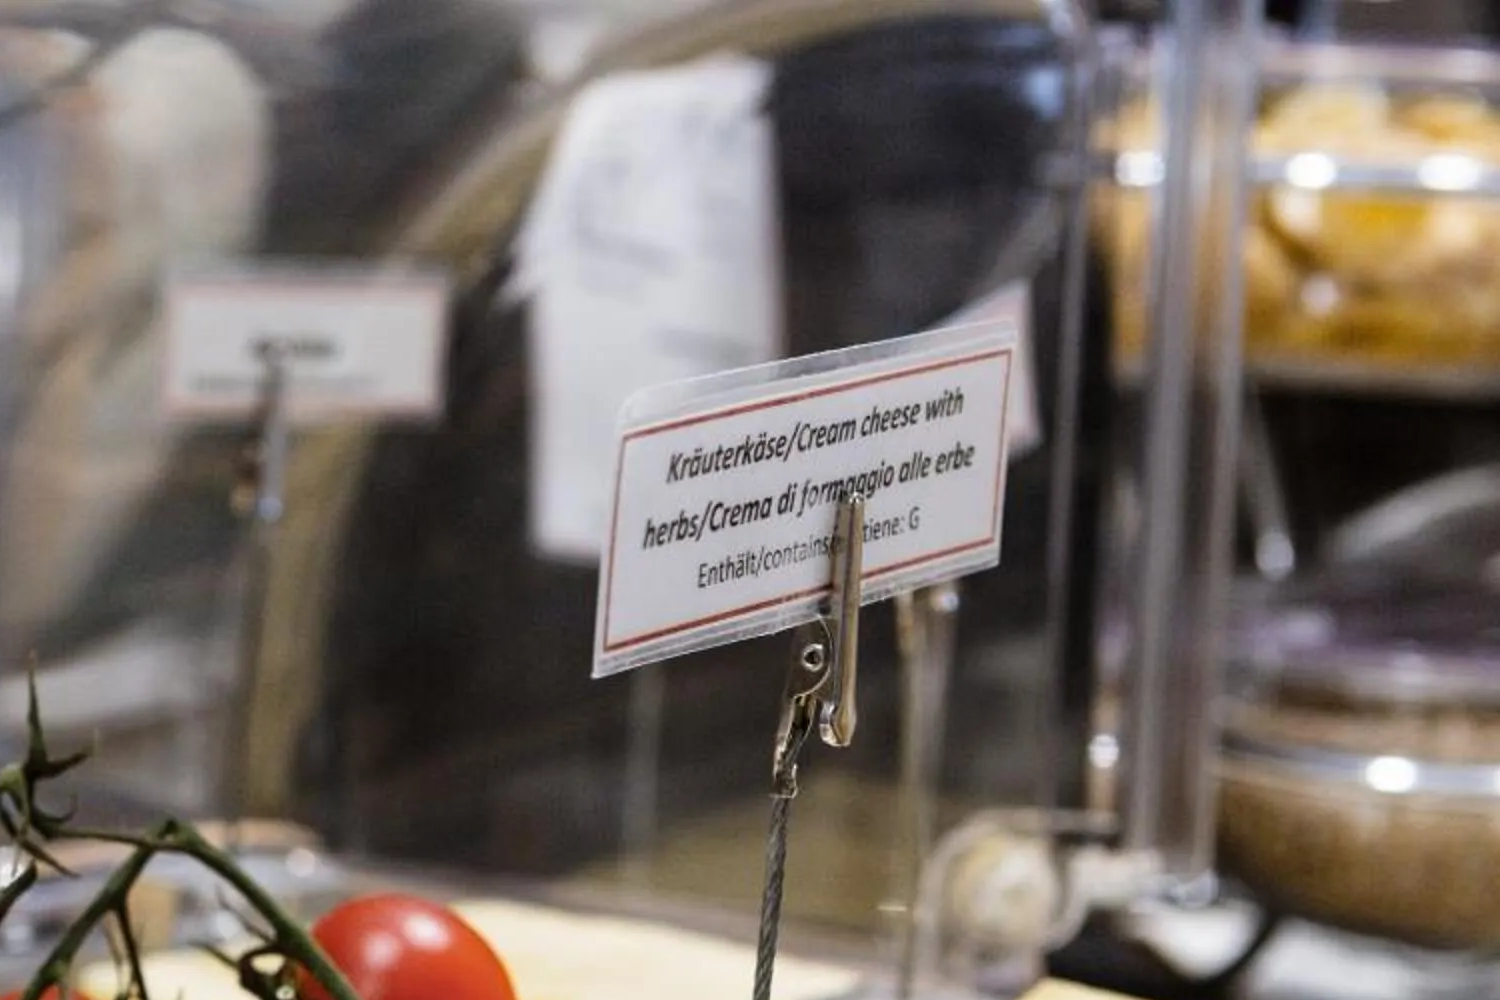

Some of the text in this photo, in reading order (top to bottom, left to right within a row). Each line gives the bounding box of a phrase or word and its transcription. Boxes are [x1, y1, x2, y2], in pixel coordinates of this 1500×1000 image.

[666, 386, 965, 483] Kräuterkäse/Cream cheese with
[642, 440, 975, 551] herbs/Crema di formaggio alle erbe
[908, 505, 921, 531] G
